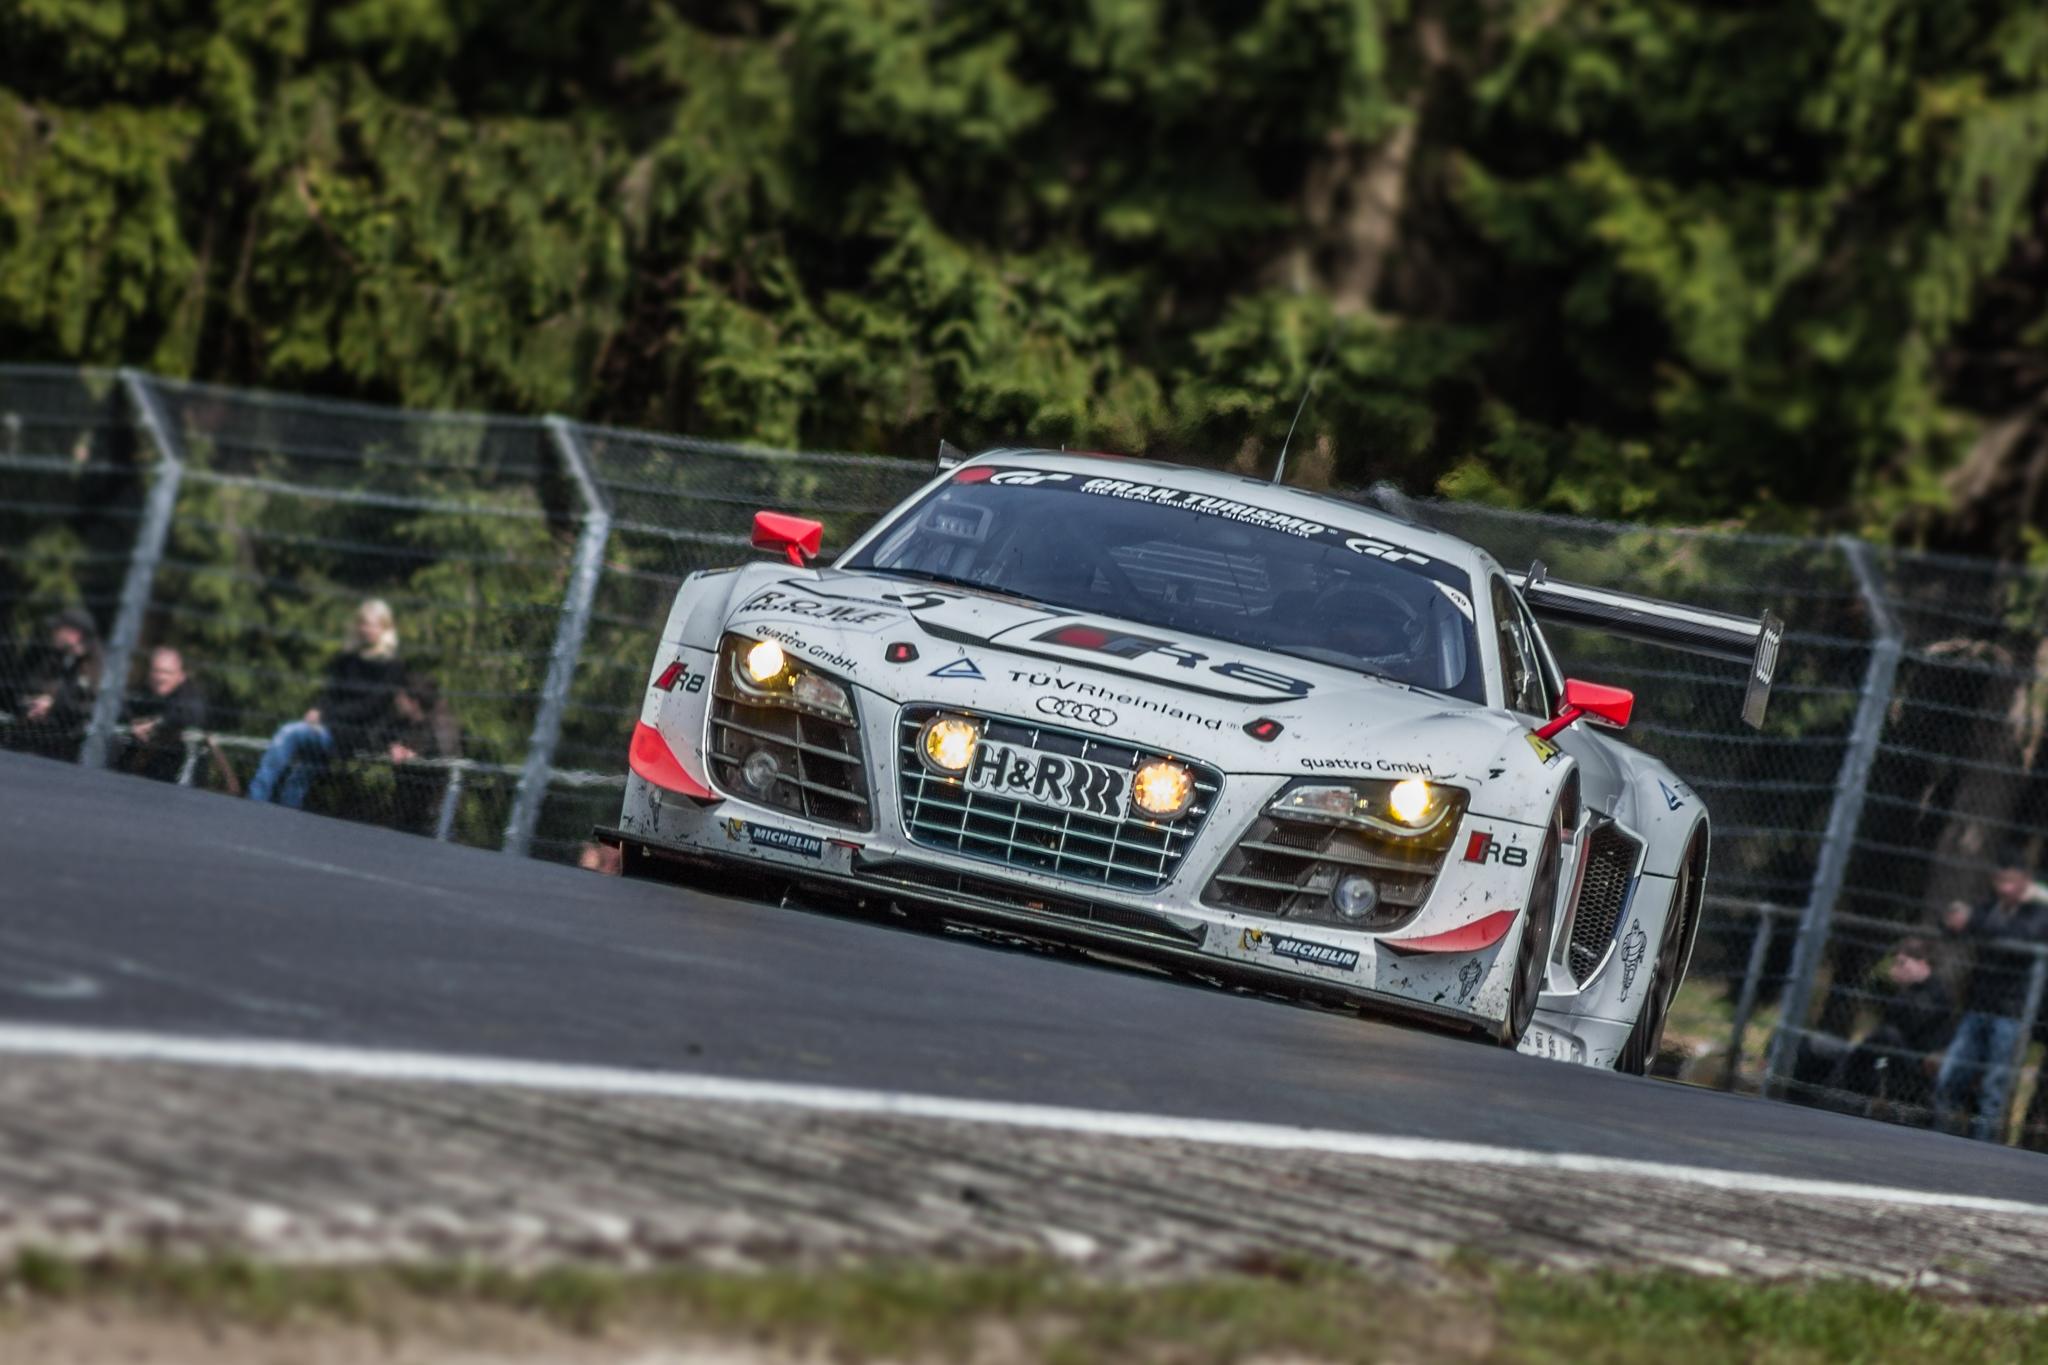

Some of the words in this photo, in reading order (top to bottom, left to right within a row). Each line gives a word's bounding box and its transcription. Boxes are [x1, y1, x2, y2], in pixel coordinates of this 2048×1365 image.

[1080, 485, 1109, 496] THE
[1112, 488, 1153, 502] REAL
[1156, 496, 1219, 516] DRIVING
[1221, 510, 1309, 539] SIMULATOR
[1084, 478, 1180, 499] GRAN
[1184, 493, 1325, 534] TURISMO
[755, 623, 807, 650] quattro
[808, 644, 859, 672] GmbH
[667, 669, 706, 694] R8
[969, 742, 1068, 801] H&R
[1300, 757, 1373, 771] quattro
[1376, 759, 1433, 777] GmbH
[753, 826, 820, 852] MICHELIN
[1479, 839, 1528, 867] R8
[1277, 939, 1357, 965] MICHELIN
